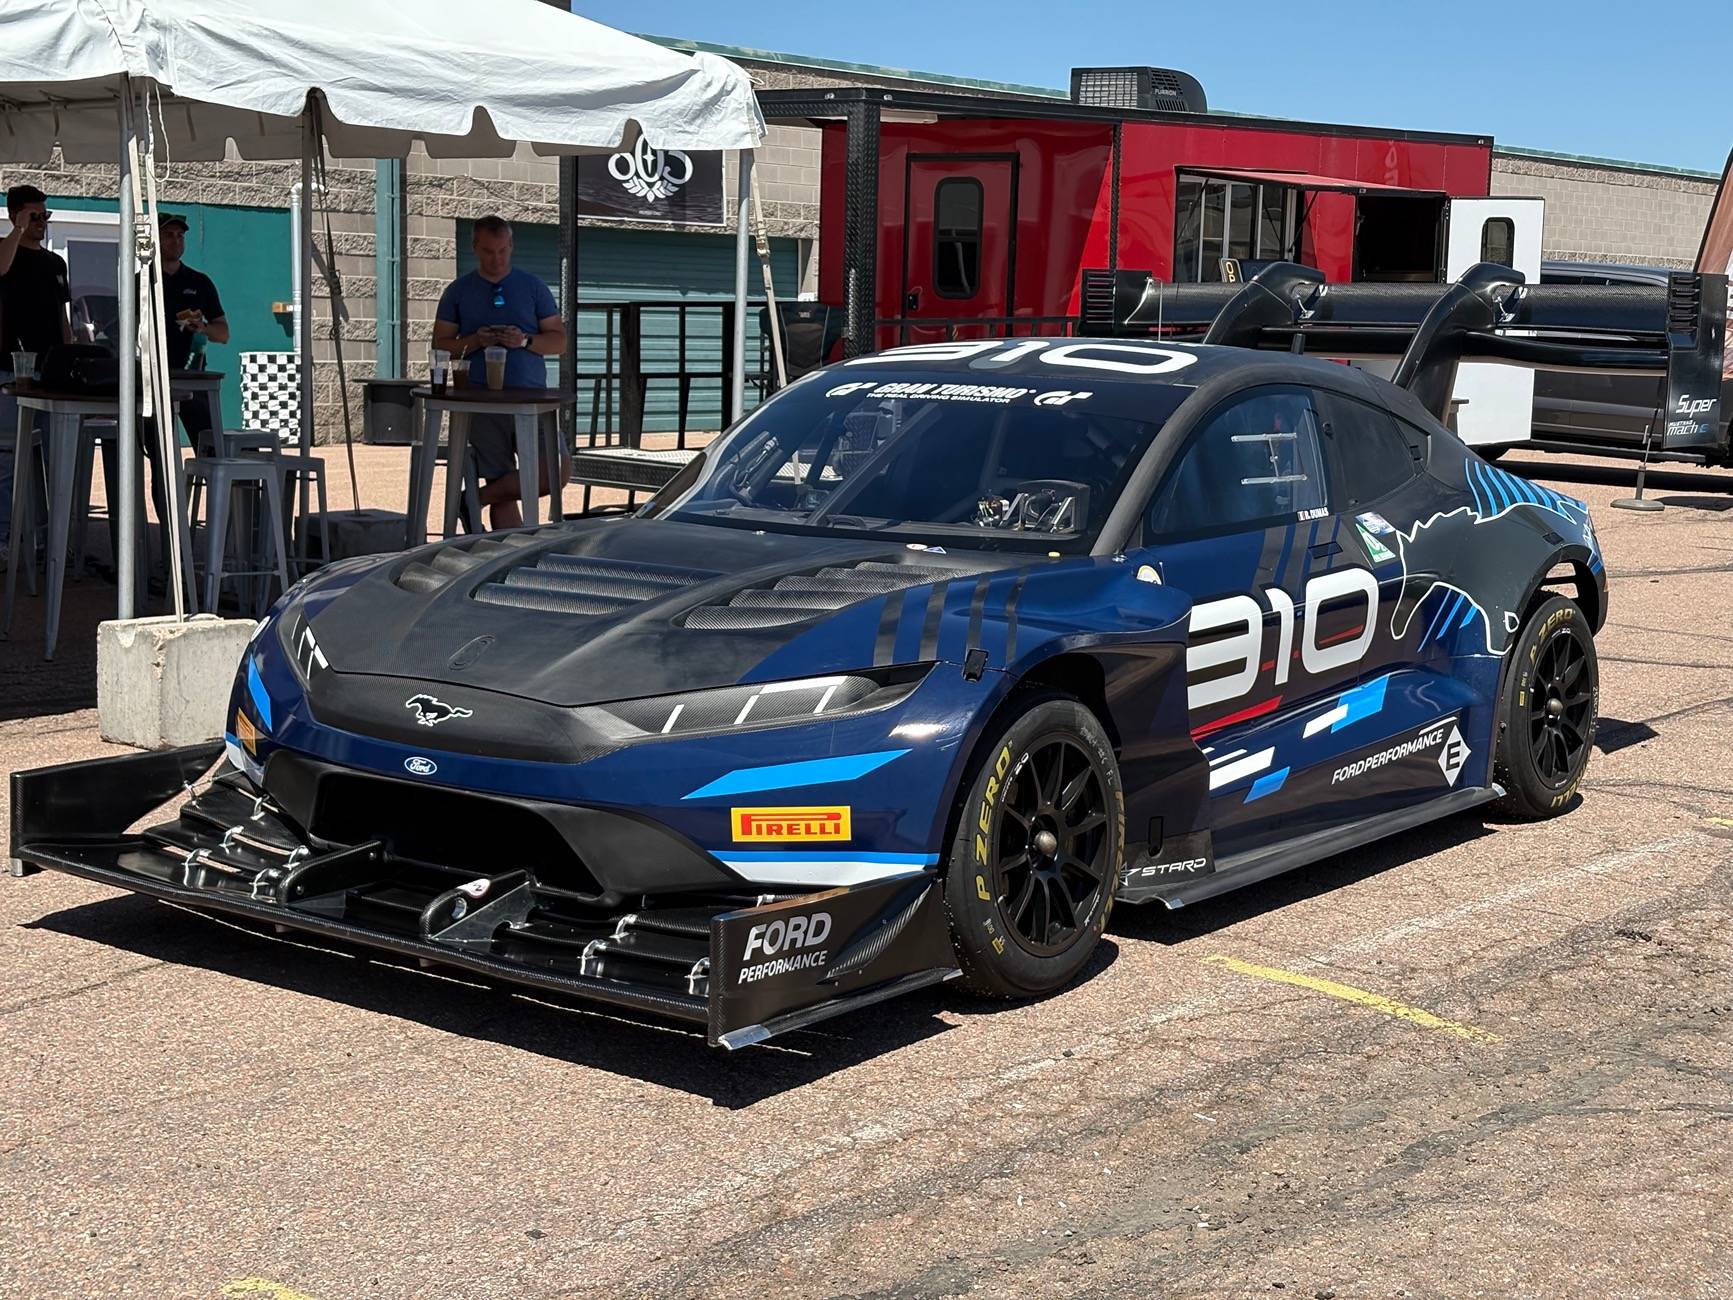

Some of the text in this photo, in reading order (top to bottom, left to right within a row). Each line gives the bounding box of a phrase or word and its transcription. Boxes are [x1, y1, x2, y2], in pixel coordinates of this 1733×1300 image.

[873, 383, 1028, 399] GRAN TURISMO
[950, 396, 1011, 404] SIMULATOR
[1676, 394, 1717, 418] Super
[1186, 567, 1379, 710] 310
[1539, 608, 1573, 645] ZERO
[408, 758, 434, 774] Ford
[976, 745, 1011, 866] ZERO
[740, 812, 842, 836] PIRELLI
[1141, 857, 1207, 877] STARD
[976, 875, 991, 901] P
[743, 912, 832, 961] FORD
[737, 950, 828, 985] PERFORMANCE
